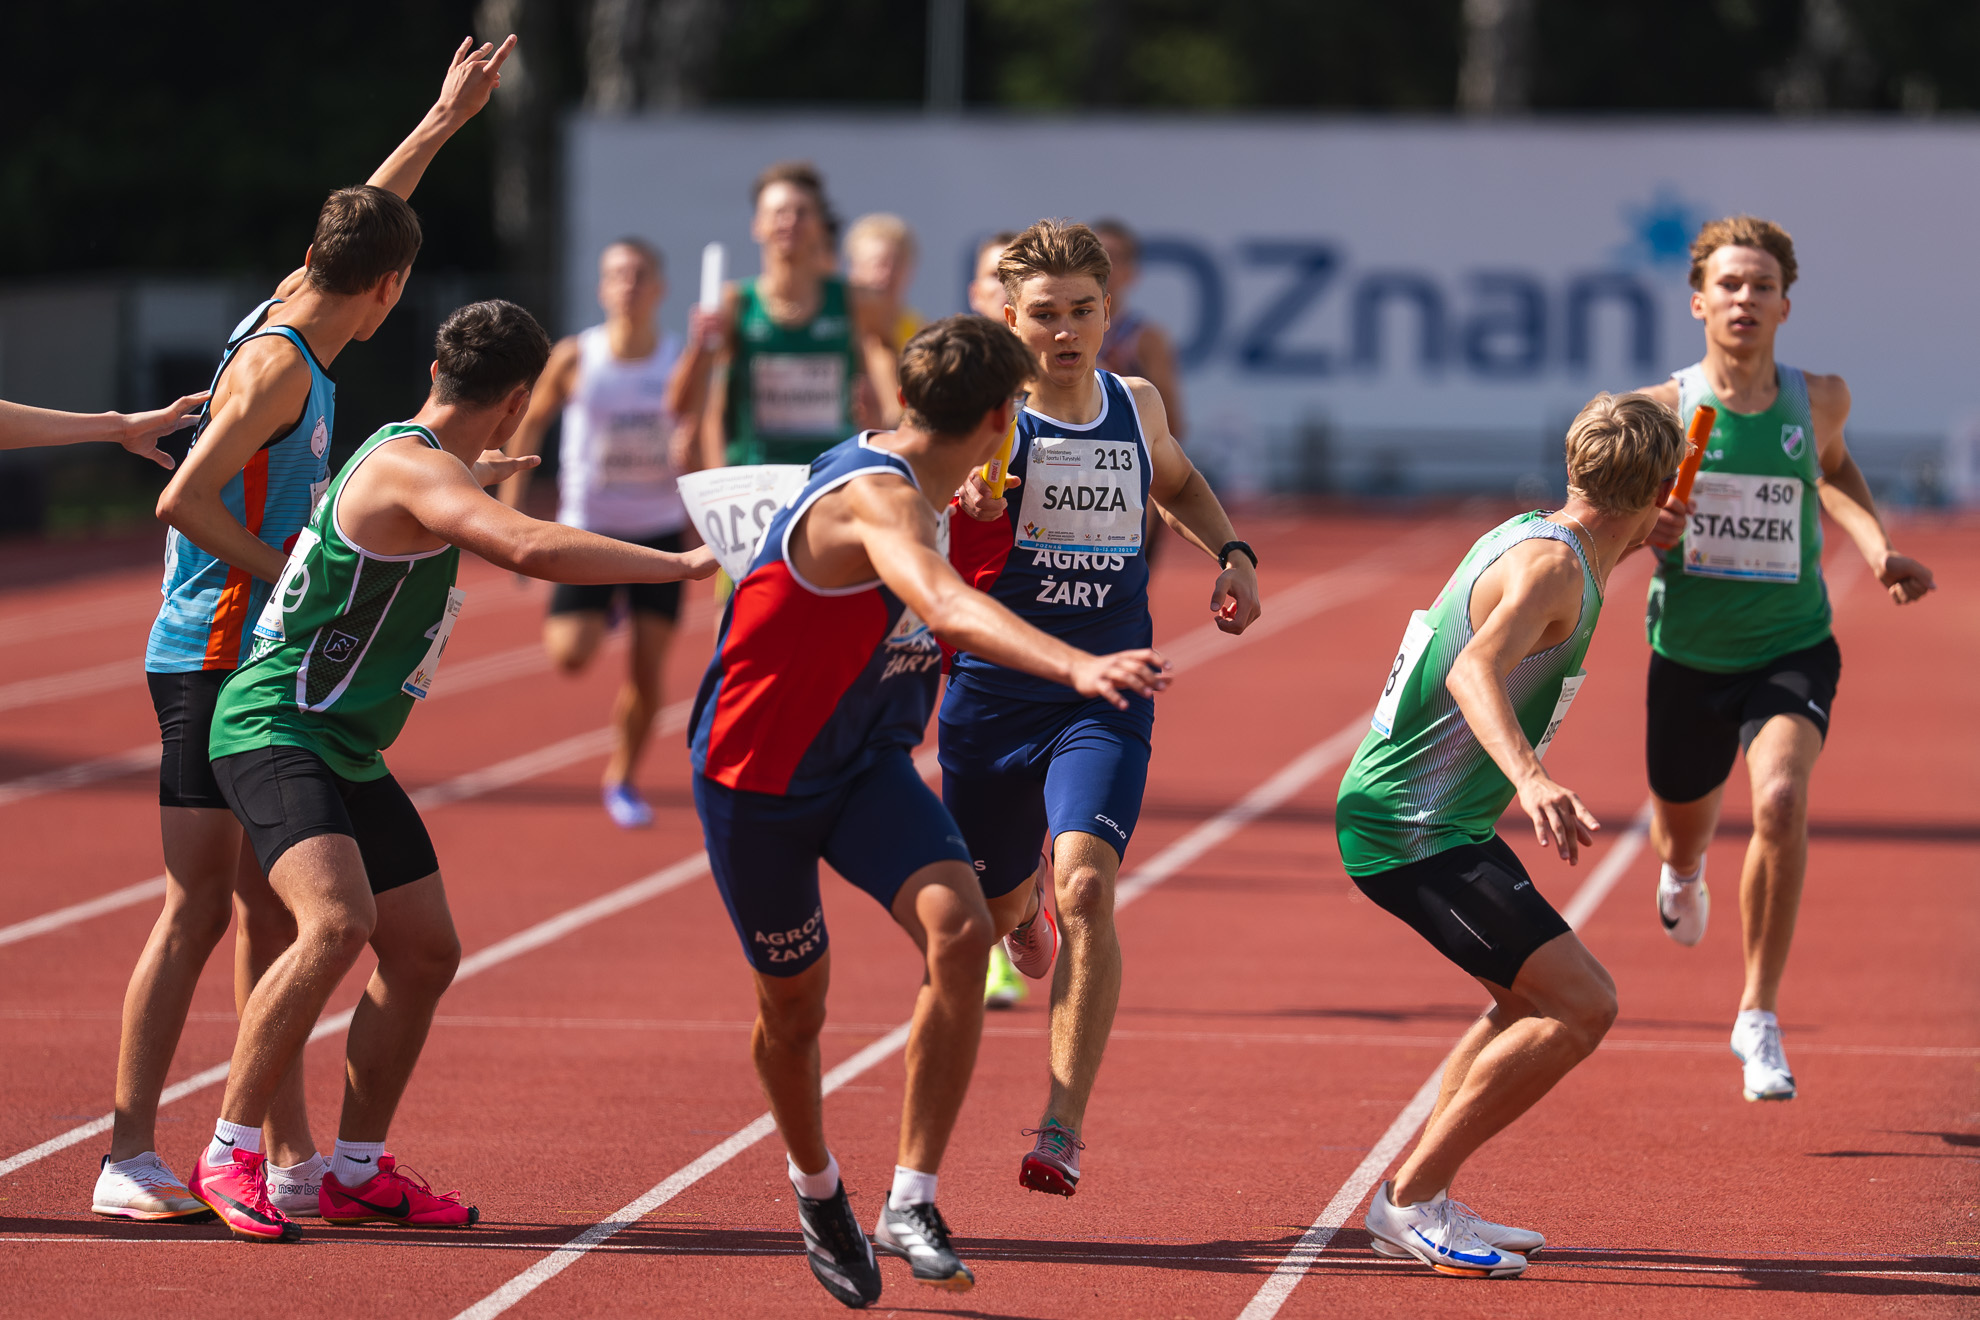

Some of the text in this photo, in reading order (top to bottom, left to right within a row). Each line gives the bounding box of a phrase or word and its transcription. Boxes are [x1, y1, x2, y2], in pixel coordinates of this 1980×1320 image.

[1094, 448, 1133, 471] 213
[1042, 485, 1127, 512] SADZA
[1755, 483, 1794, 504] 450
[1693, 513, 1794, 542] STASZEK
[1031, 550, 1125, 571] AGROS
[1036, 574, 1112, 608] ŻARY
[1094, 813, 1127, 840] COLO
[755, 905, 821, 946] AGROS
[767, 927, 821, 962] ŻARY
[279, 1184, 303, 1195] new
